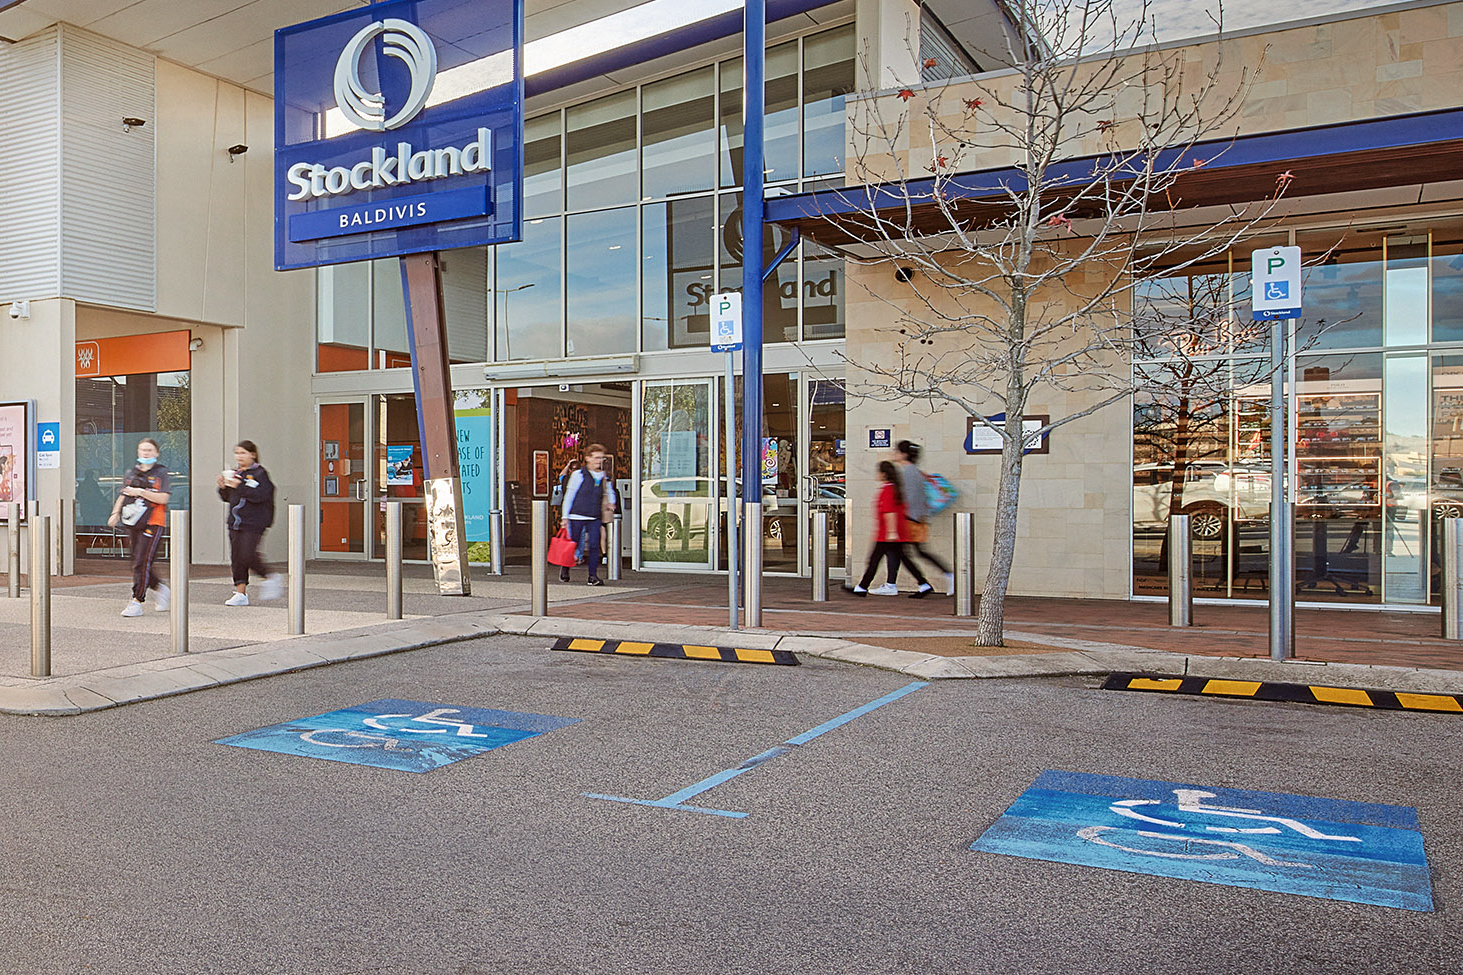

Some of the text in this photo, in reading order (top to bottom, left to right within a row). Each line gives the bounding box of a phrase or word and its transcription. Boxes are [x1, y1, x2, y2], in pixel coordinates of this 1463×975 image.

[287, 127, 492, 202] Stockland
[339, 201, 427, 228] BALDIVIS
[1267, 257, 1286, 275] P
[719, 301, 731, 315] P
[474, 447, 485, 460] OF
